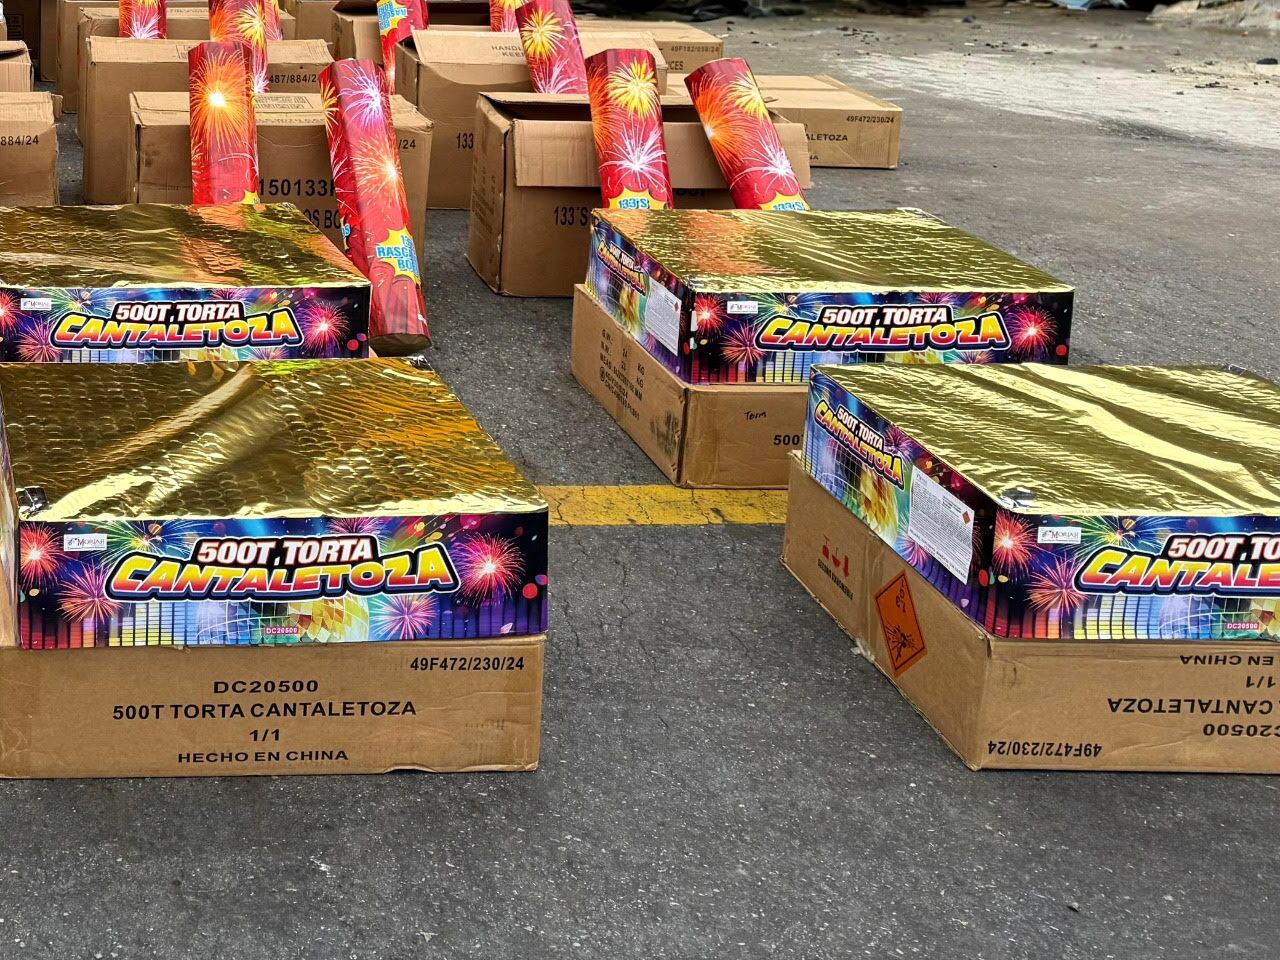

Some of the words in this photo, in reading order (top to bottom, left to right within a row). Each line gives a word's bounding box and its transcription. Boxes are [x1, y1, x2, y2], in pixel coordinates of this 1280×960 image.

[668, 61, 684, 71] CES
[456, 132, 474, 150] 133
[116, 304, 170, 321] 500T
[174, 304, 240, 322] TORTA
[822, 310, 874, 324] 500T
[880, 308, 948, 326] TORTA
[55, 312, 298, 343] CANTALETOZA
[760, 316, 1006, 346] CANTALETOZA
[816, 401, 904, 484] CANTALETOZA
[858, 422, 884, 450] TORTA
[198, 541, 276, 564] 500T
[284, 538, 372, 564] TORTA
[1169, 538, 1245, 560] 500T
[112, 548, 453, 593] CANTALETOZA
[1081, 550, 1280, 588] CANTALE
[410, 656, 524, 671] 49F472/230/24
[1180, 655, 1242, 666] CHINA
[1248, 656, 1274, 666] EN
[214, 680, 319, 694] DC20500
[1246, 676, 1276, 688] 1/1
[113, 705, 164, 720] 500T
[170, 704, 245, 719] TORTA
[250, 702, 417, 718] CANTALETOZA
[1108, 698, 1273, 714] CANTALETOZA
[249, 729, 280, 742] 1/1
[1202, 724, 1280, 738] 20500
[178, 752, 249, 763] HECHO
[254, 751, 280, 762] EN
[286, 750, 348, 761] CHINA
[988, 741, 1102, 757] 49F472/230/24
